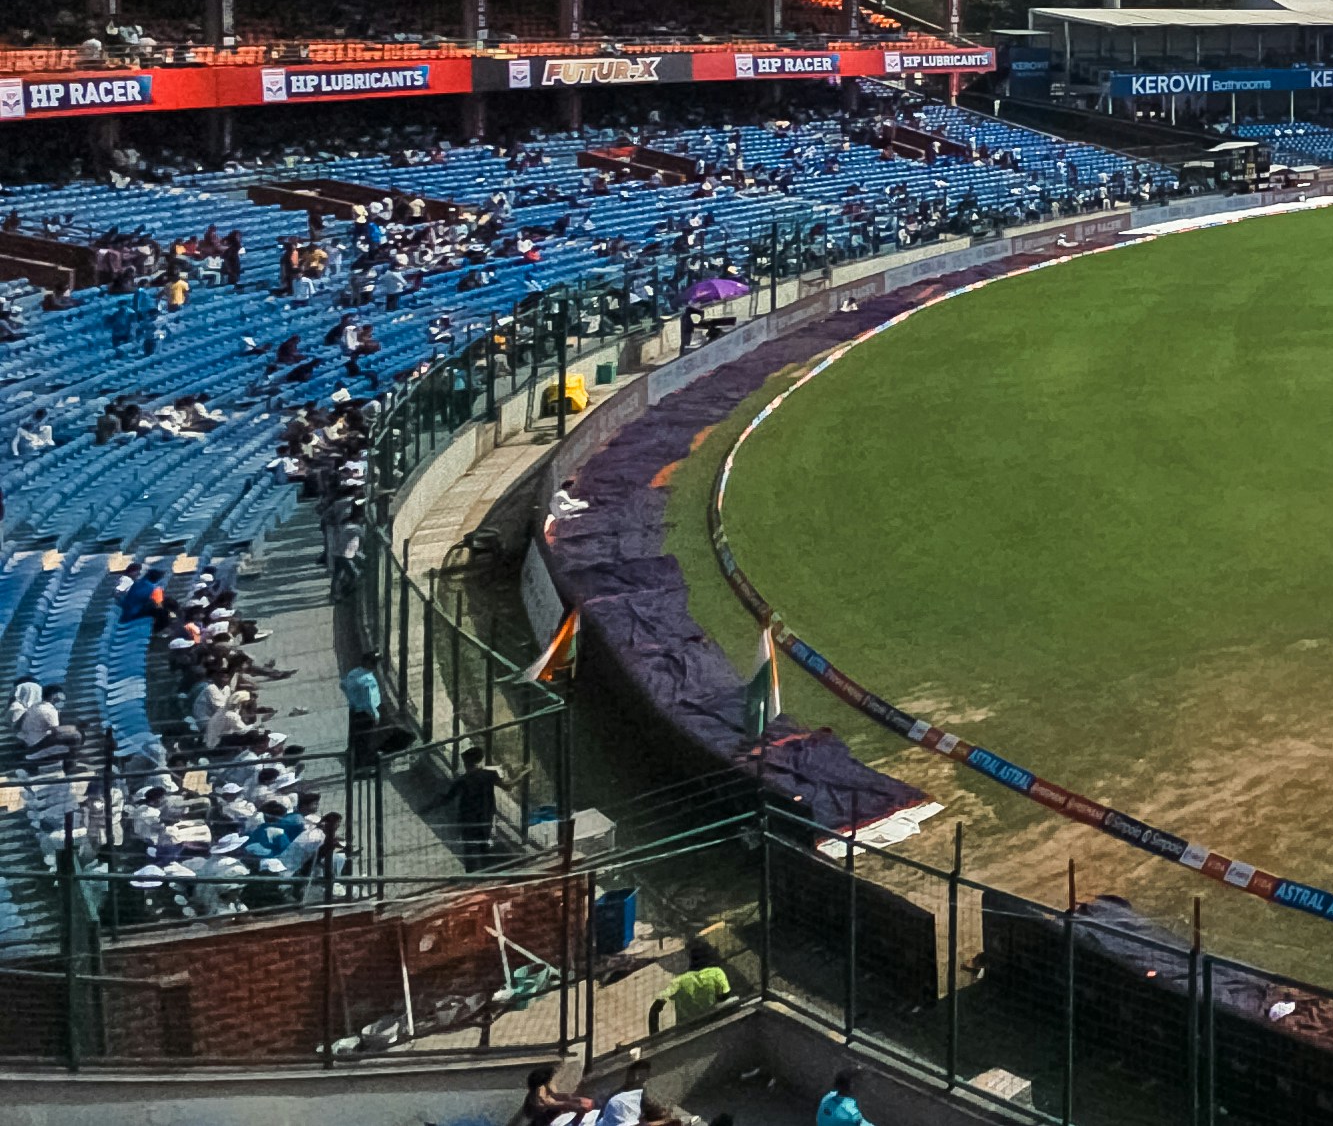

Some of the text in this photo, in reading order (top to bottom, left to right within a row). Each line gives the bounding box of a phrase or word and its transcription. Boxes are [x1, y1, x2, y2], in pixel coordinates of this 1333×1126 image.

[542, 56, 663, 86] FUTUR-X
[757, 57, 834, 73] HP RACER
[903, 54, 988, 68] HP LUBRICANTS
[290, 70, 424, 93] HP LUBRICANTS
[1131, 74, 1272, 95] KEROVIT Bathrooms
[29, 80, 142, 108] HP RACER
[1274, 881, 1324, 911] ASTRAL
